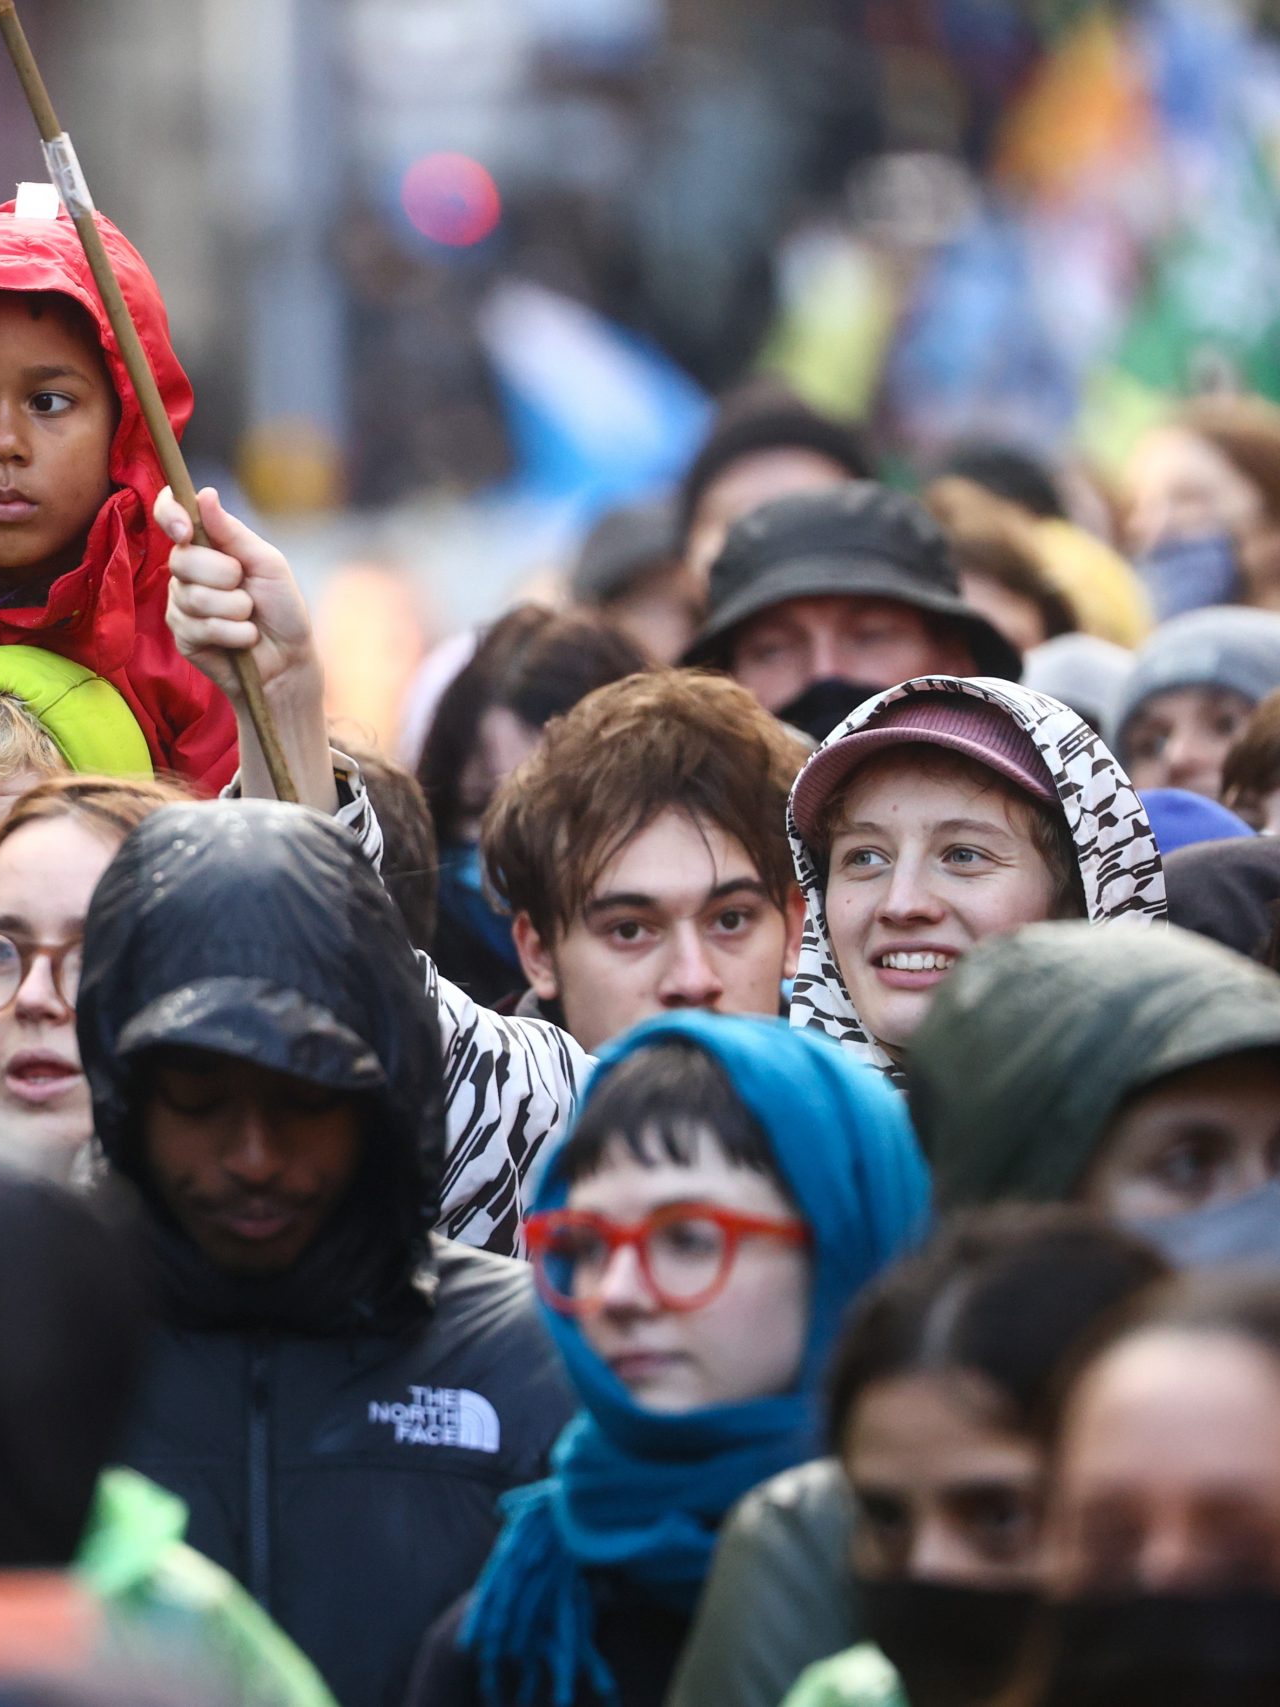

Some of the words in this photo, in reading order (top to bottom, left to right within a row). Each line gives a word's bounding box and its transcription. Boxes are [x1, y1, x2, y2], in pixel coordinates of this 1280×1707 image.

[409, 1385, 459, 1406] THE
[368, 1401, 459, 1425] NORTH
[394, 1424, 459, 1446] FACE
